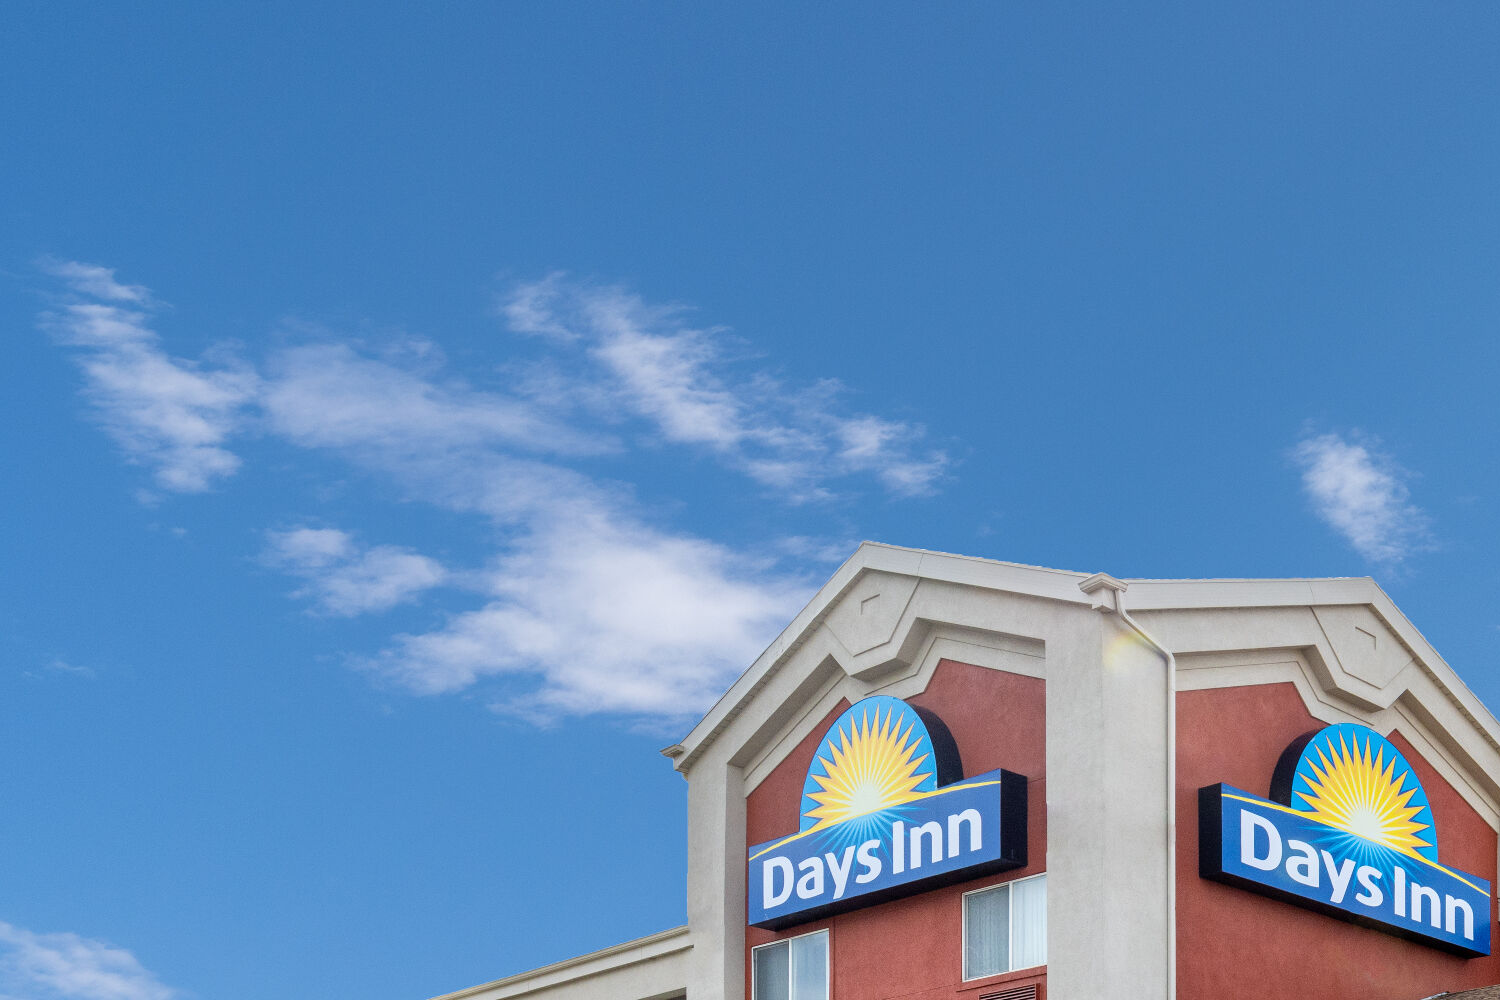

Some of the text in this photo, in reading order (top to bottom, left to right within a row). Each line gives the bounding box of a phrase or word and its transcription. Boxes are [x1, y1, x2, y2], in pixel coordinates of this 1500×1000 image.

[762, 808, 983, 910] Days Inn
[1240, 808, 1474, 941] Days Inn
